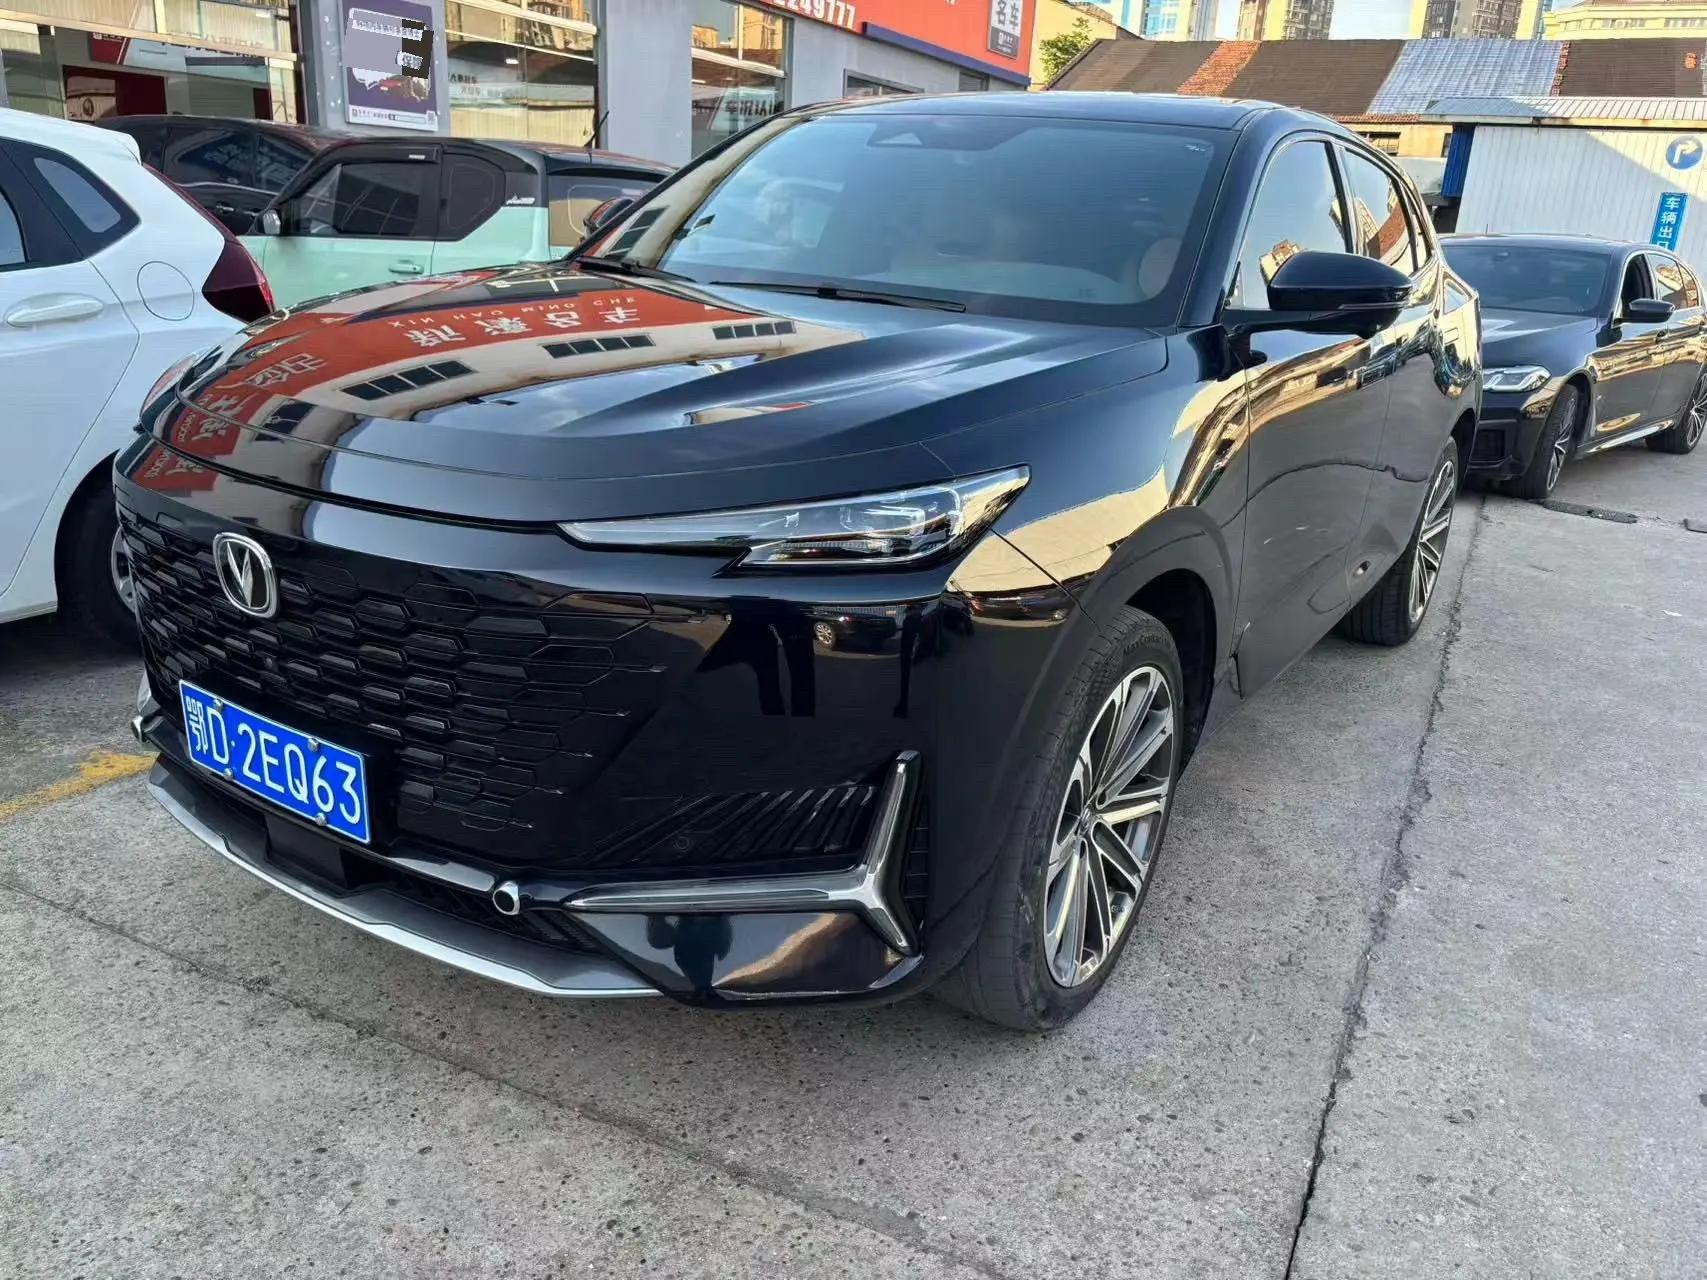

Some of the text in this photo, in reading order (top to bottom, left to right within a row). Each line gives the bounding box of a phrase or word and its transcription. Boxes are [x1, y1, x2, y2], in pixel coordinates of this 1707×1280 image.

[773, 0, 856, 29] 49777
[1657, 197, 1680, 250] 车辆出口
